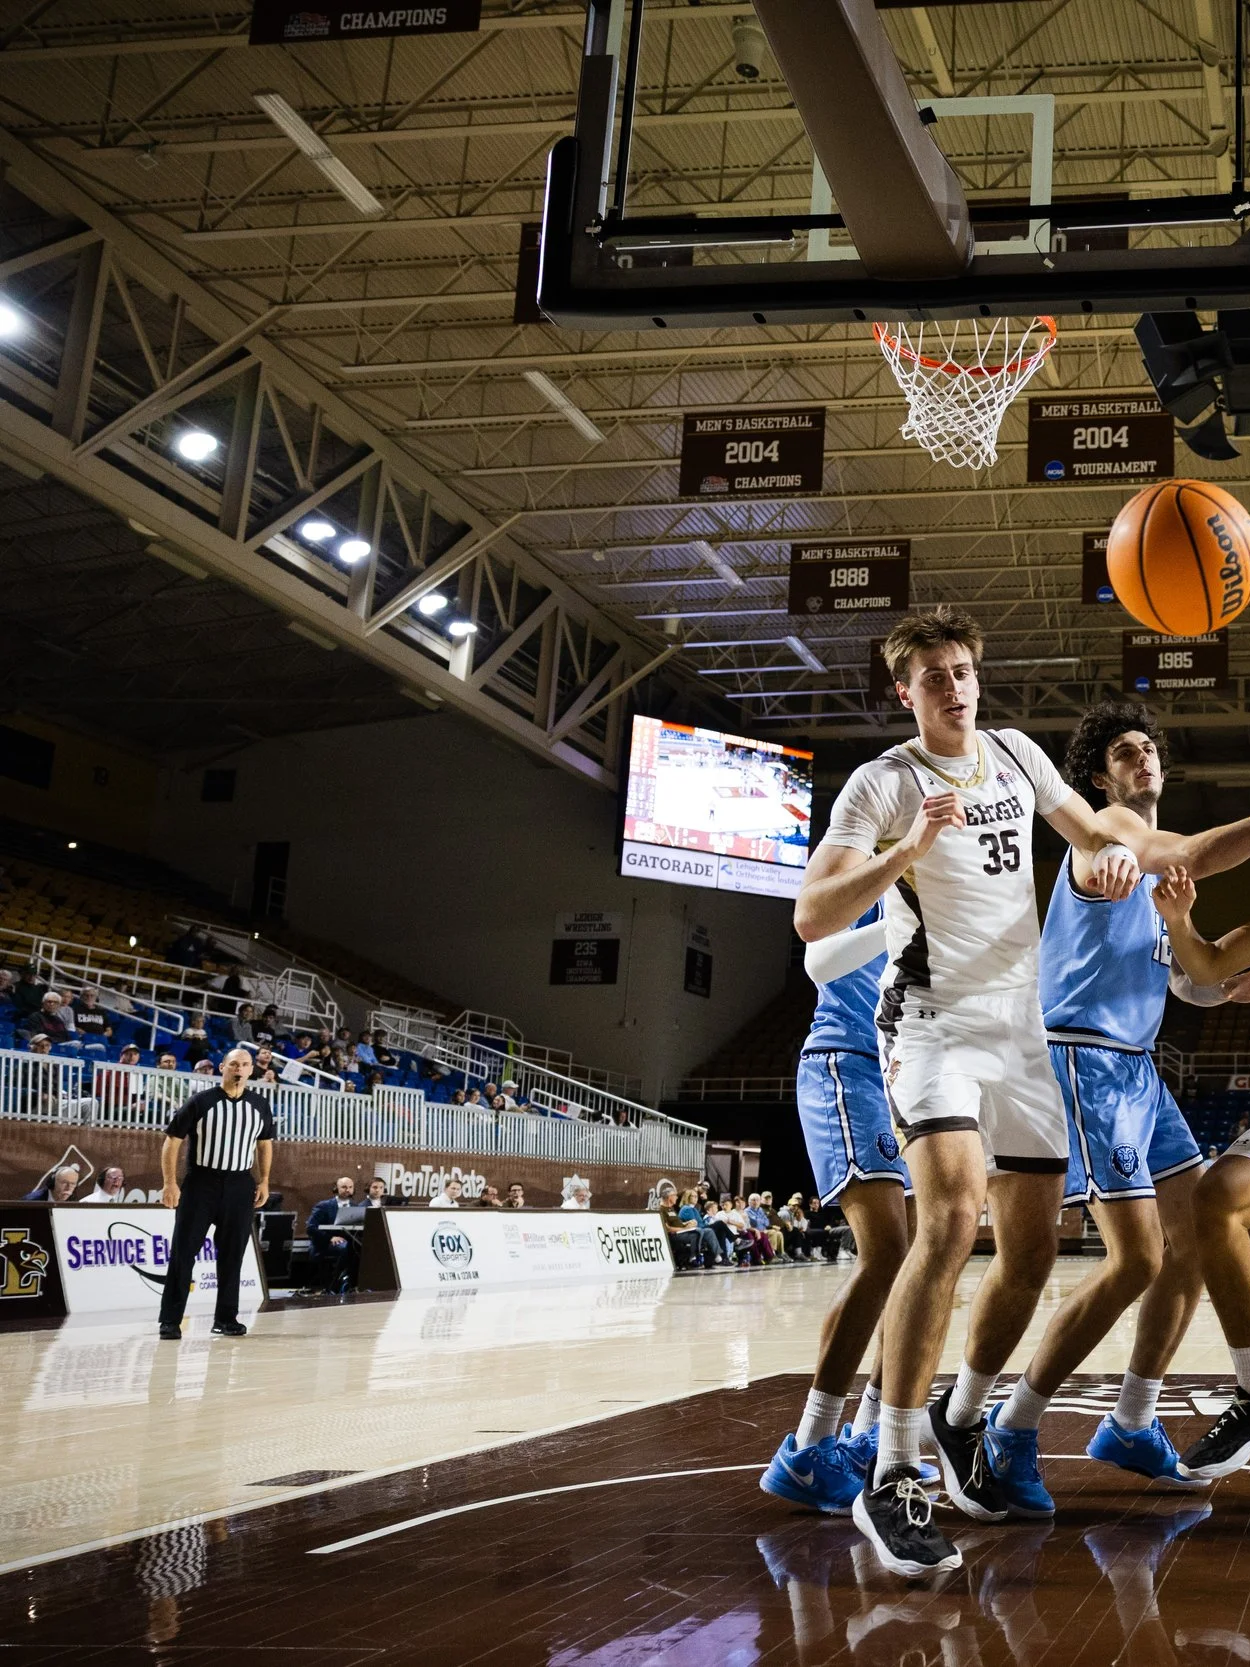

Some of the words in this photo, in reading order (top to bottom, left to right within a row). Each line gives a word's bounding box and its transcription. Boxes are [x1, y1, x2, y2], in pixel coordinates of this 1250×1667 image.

[340, 8, 447, 31] CHAMPIONS
[1041, 405, 1079, 417] MEN'S
[1082, 401, 1161, 415] BASKETBALL
[695, 419, 733, 432] MEN'S
[735, 416, 812, 431] BASKETBALL
[1073, 425, 1129, 450] 2004
[725, 440, 780, 464] 2004
[1073, 460, 1157, 475] TOURNAMENT
[734, 475, 802, 489] CHAMPIONS
[801, 549, 833, 560] MEN'S
[835, 546, 900, 559] BASKETBALL
[1207, 513, 1245, 619] Wilson
[829, 567, 869, 588] 1988
[834, 596, 891, 609] CHAMPIONS
[1132, 636, 1160, 645] MEN'S
[1161, 633, 1219, 645] BASKETBALL
[1158, 652, 1193, 669] 1985
[1155, 678, 1216, 689] TOURNAMENT
[978, 829, 1020, 876] 35
[626, 853, 714, 877] GATORADE
[736, 861, 761, 872] Lehigh
[761, 864, 781, 875] Valley
[736, 870, 776, 883] Orthopedic
[778, 874, 802, 886] Institut
[564, 923, 612, 932] WRESTLING
[574, 942, 598, 956] 235
[613, 1226, 646, 1236] HONEY
[438, 1234, 465, 1254] FOX
[616, 1237, 666, 1264] STINGER
[68, 1235, 146, 1270] SERVICE
[441, 1253, 468, 1262] SPORTS
